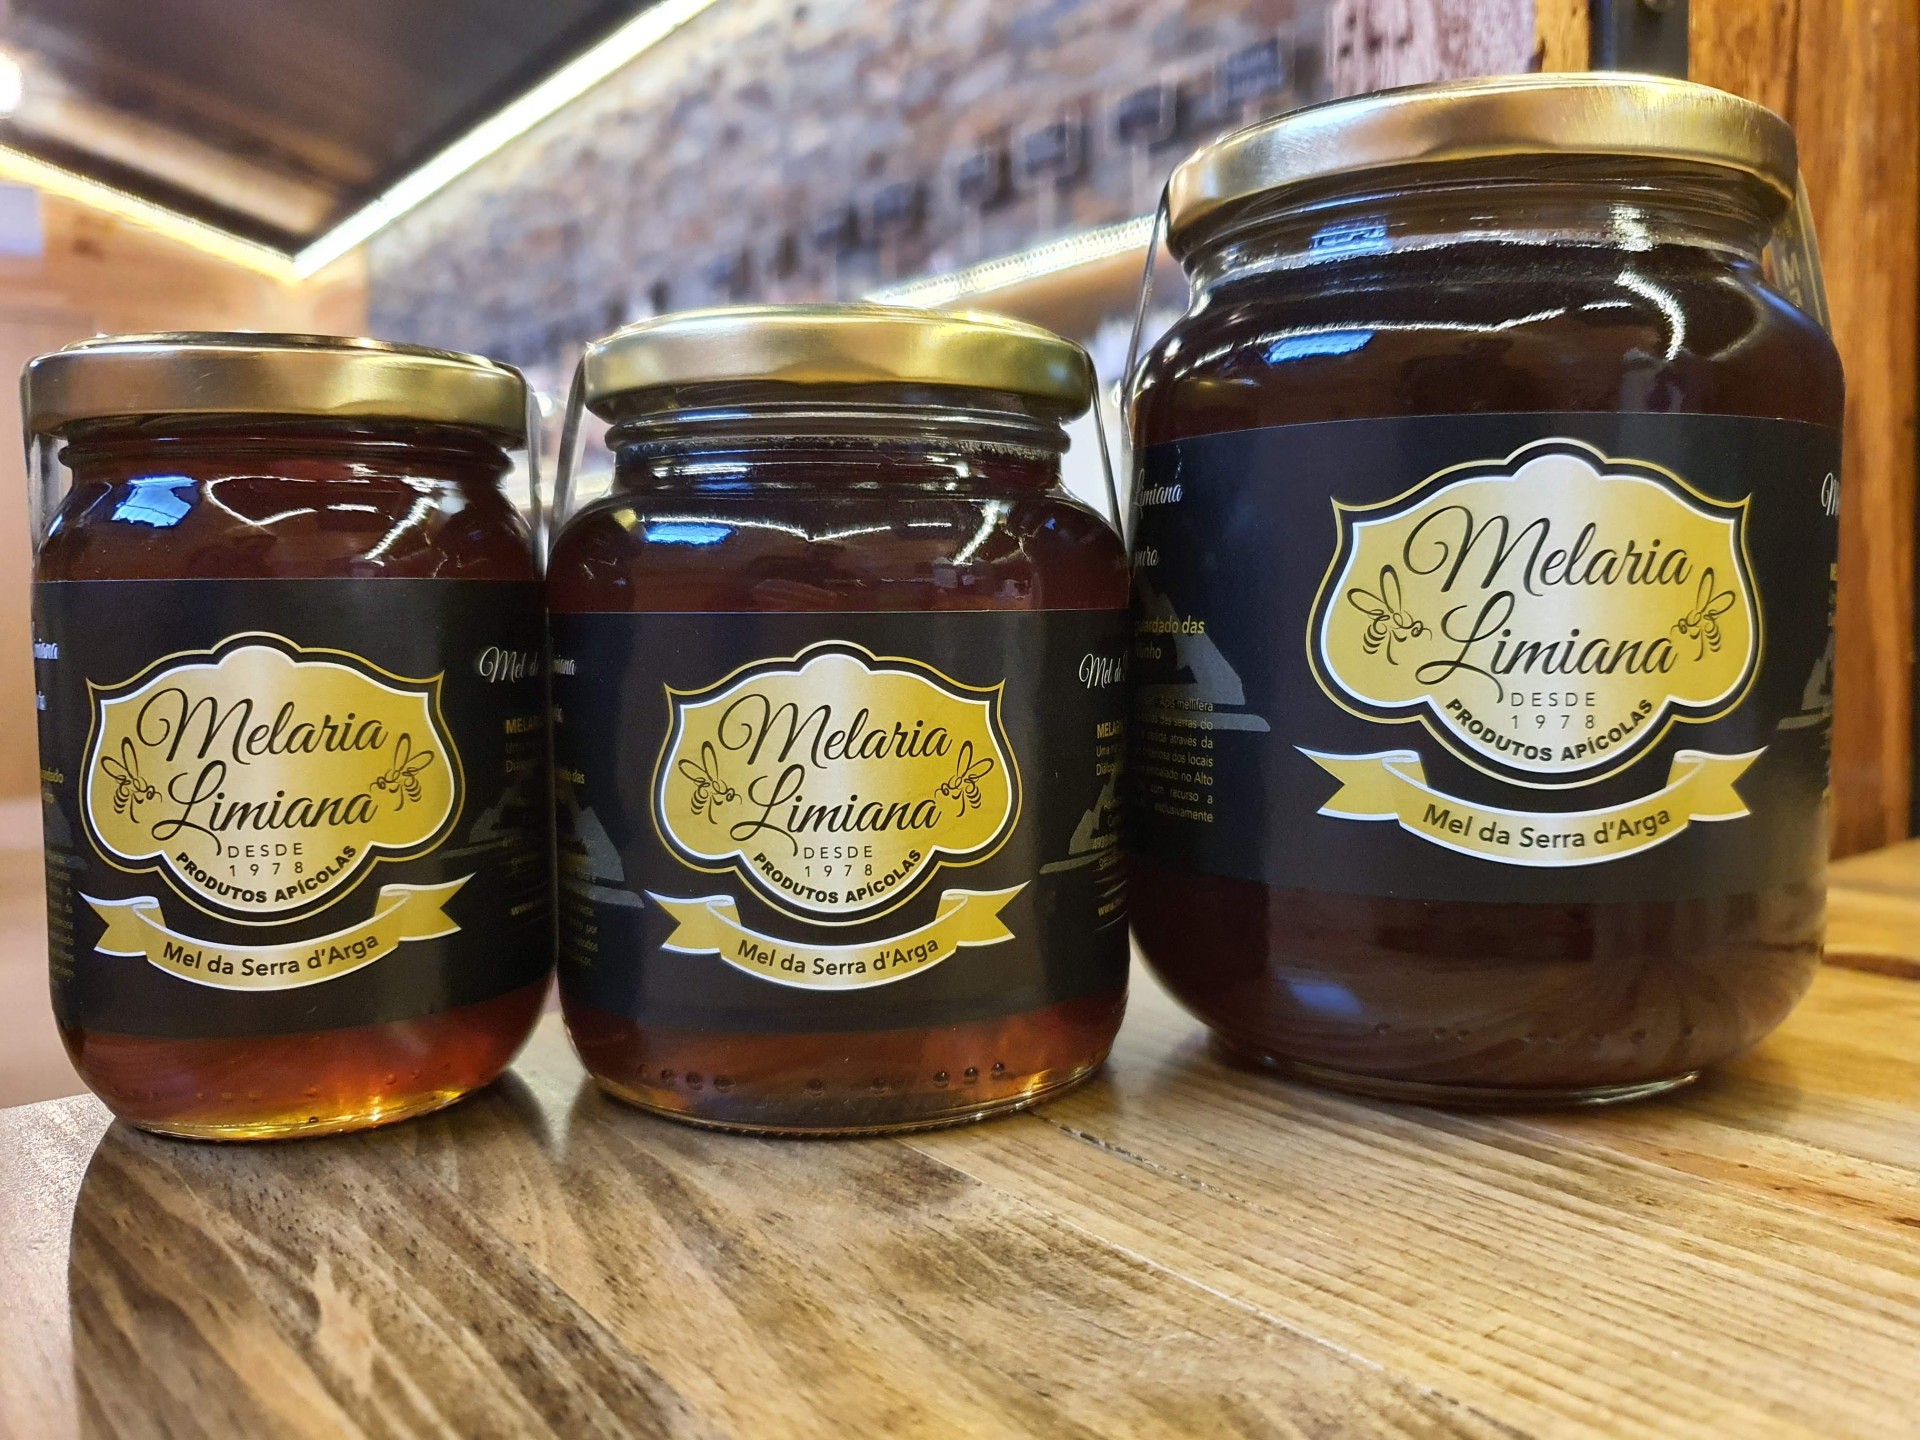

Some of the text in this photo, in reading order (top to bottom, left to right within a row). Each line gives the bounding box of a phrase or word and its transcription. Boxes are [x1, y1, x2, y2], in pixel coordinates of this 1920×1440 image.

[1403, 506, 1693, 597] Melaria
[1181, 614, 1206, 635] das
[1416, 590, 1678, 704] Limiana
[1078, 652, 1114, 690] Mel
[1177, 697, 1214, 711] mellifera
[1510, 691, 1597, 708] DESDE
[136, 687, 389, 765] Melaria
[717, 693, 954, 769] Melaria
[1200, 717, 1214, 731] do
[1446, 697, 1654, 762] PRODUTOS APÍCOLAS
[1511, 713, 1596, 730] 1978
[1200, 735, 1214, 749] da
[1187, 751, 1214, 768] locais
[1181, 772, 1192, 783] no
[1194, 771, 1214, 786] Alto
[152, 760, 378, 856] Limiana
[730, 763, 942, 857] Limiana
[1169, 787, 1199, 802] recurso
[1206, 794, 1214, 804] a
[1423, 803, 1473, 838] Mel
[1478, 821, 1511, 847] da
[1519, 825, 1586, 849] Serra
[227, 842, 304, 860] DESDE
[804, 845, 874, 860] DESDE
[176, 844, 358, 904] PRODUTOS APÍCOLAS
[229, 861, 305, 878] 1978
[753, 847, 923, 904] PRODUTOS APÍCOLAS
[804, 864, 874, 878] 1978
[162, 940, 202, 969] Mel
[206, 955, 235, 977] da
[241, 957, 301, 978] Serra
[737, 939, 775, 968] Mel
[780, 954, 806, 976] da
[812, 957, 867, 977] Serra
